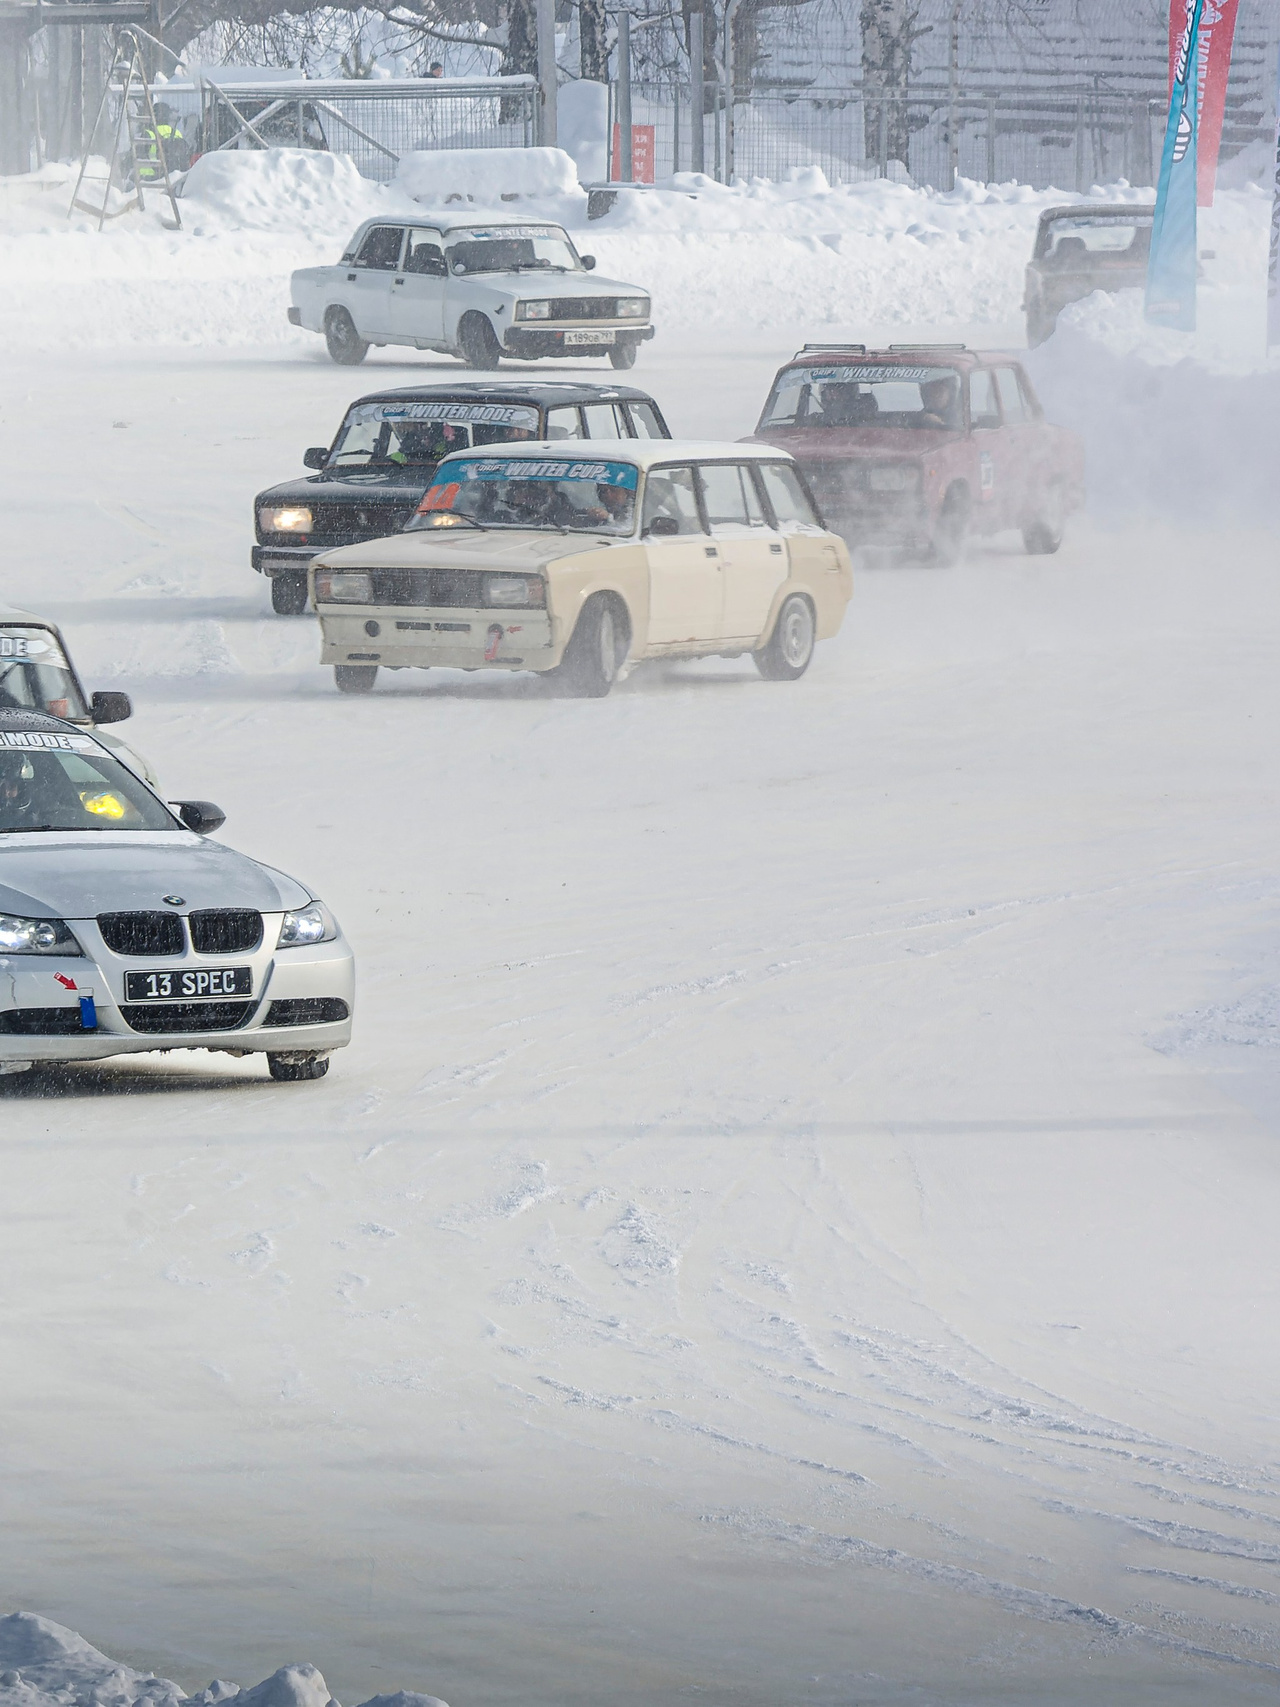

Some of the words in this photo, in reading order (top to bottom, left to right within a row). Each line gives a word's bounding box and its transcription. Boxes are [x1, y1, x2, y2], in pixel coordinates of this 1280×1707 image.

[843, 367, 893, 379] WINTER
[893, 368, 930, 379] MODE
[409, 404, 470, 420] WINTER
[470, 405, 515, 421] MODE
[504, 462, 570, 477] WINTER
[569, 463, 606, 479] CUP
[4, 732, 73, 750] MODE
[147, 973, 172, 997] 13
[182, 970, 236, 995] SPEC
